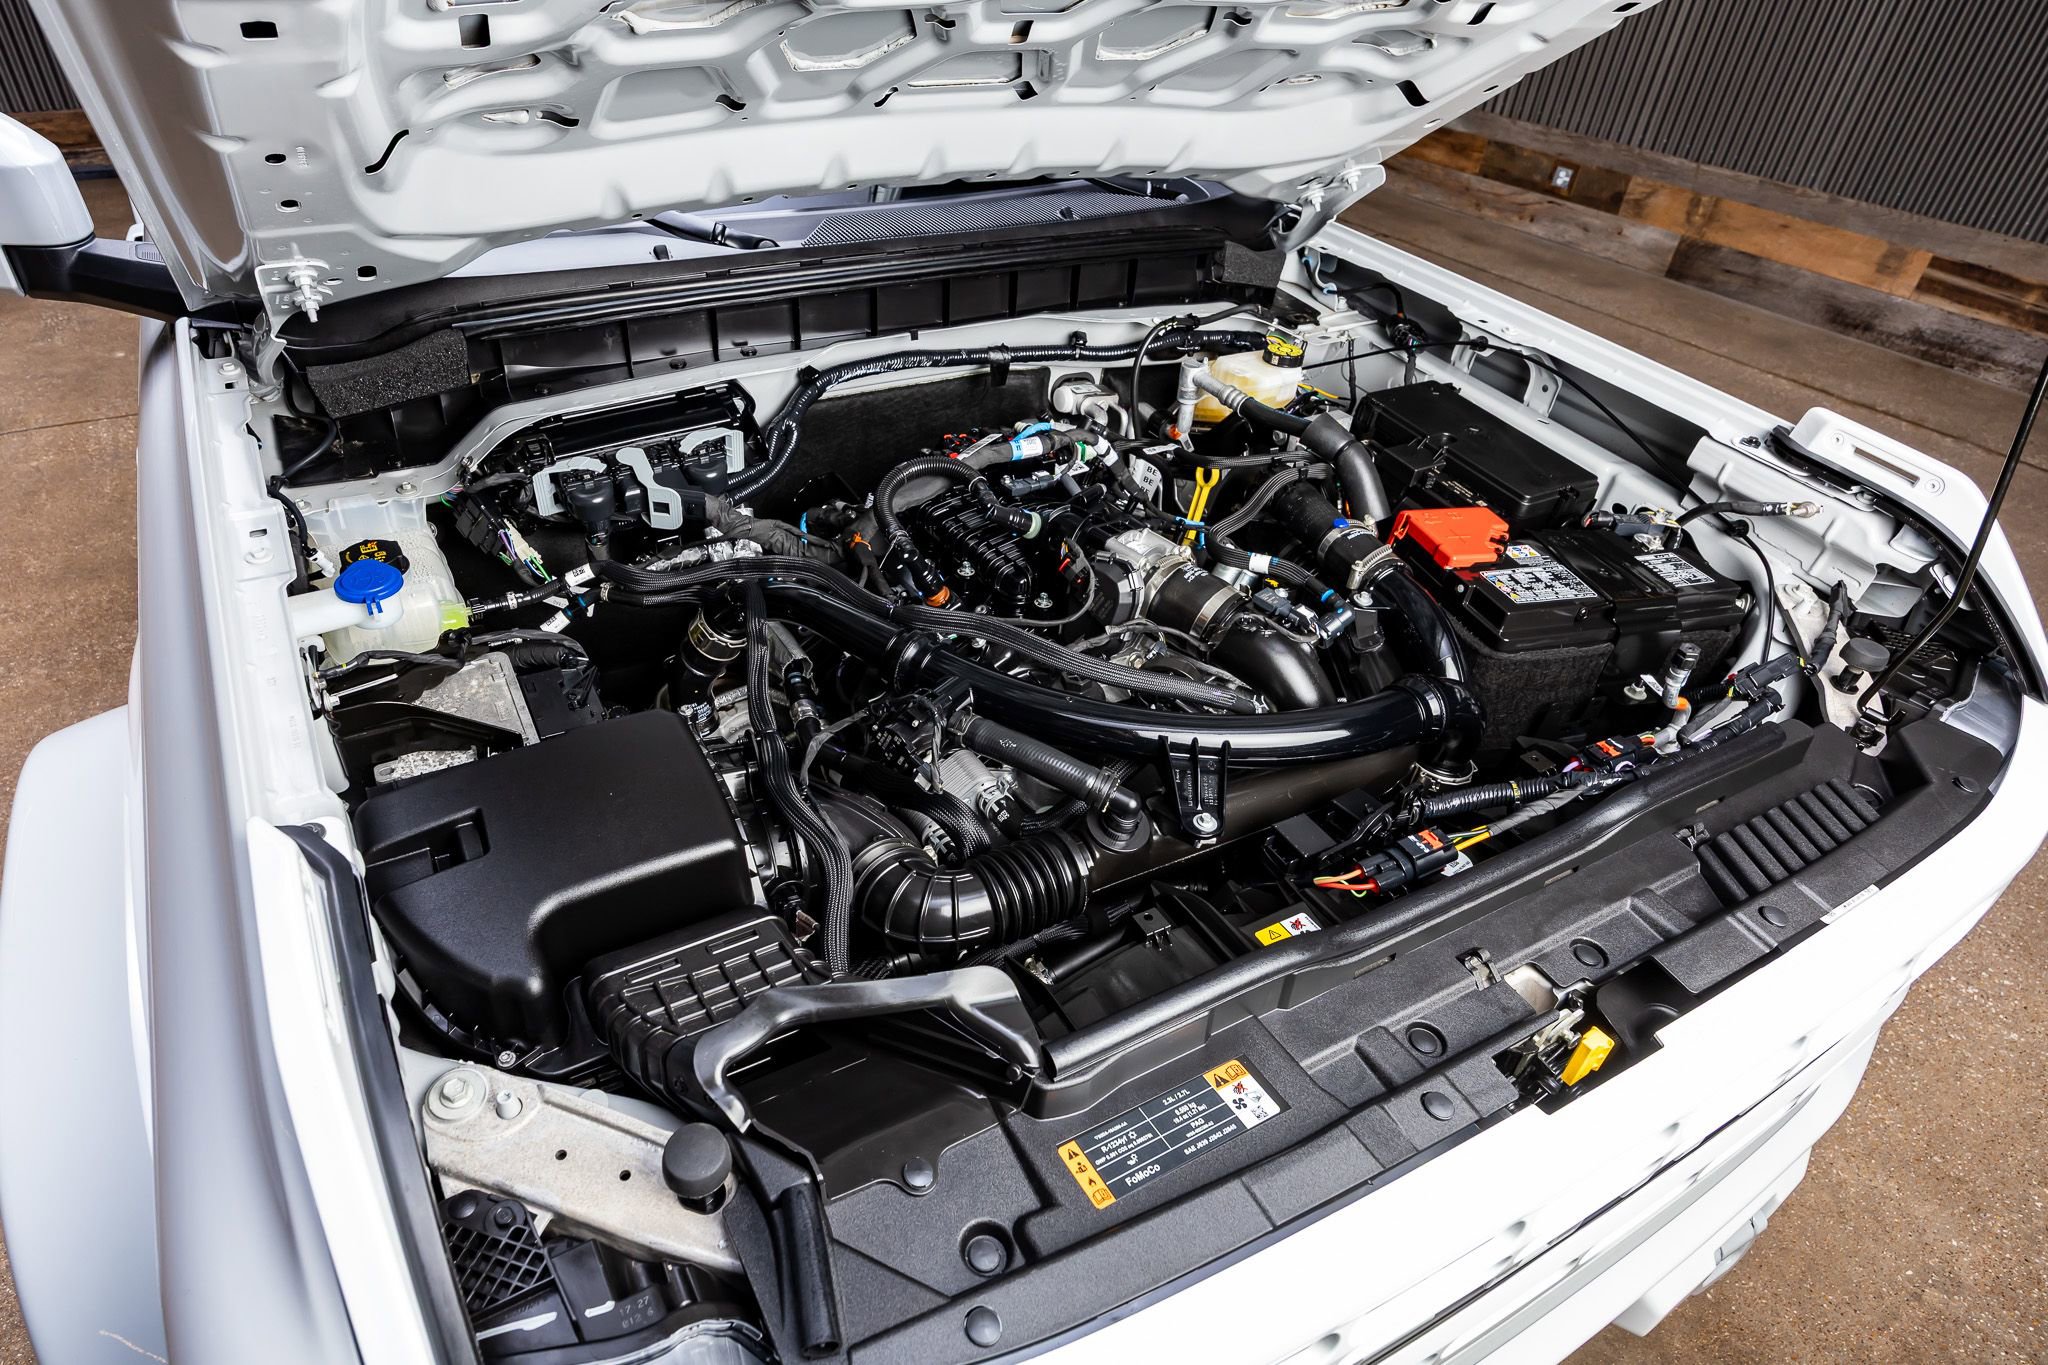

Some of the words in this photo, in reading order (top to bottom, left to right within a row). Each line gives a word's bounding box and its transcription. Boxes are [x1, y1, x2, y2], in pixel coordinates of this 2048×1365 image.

[1146, 466, 1158, 476] BE
[1143, 476, 1154, 486] BE
[1124, 1164, 1161, 1187] FoMoCo
